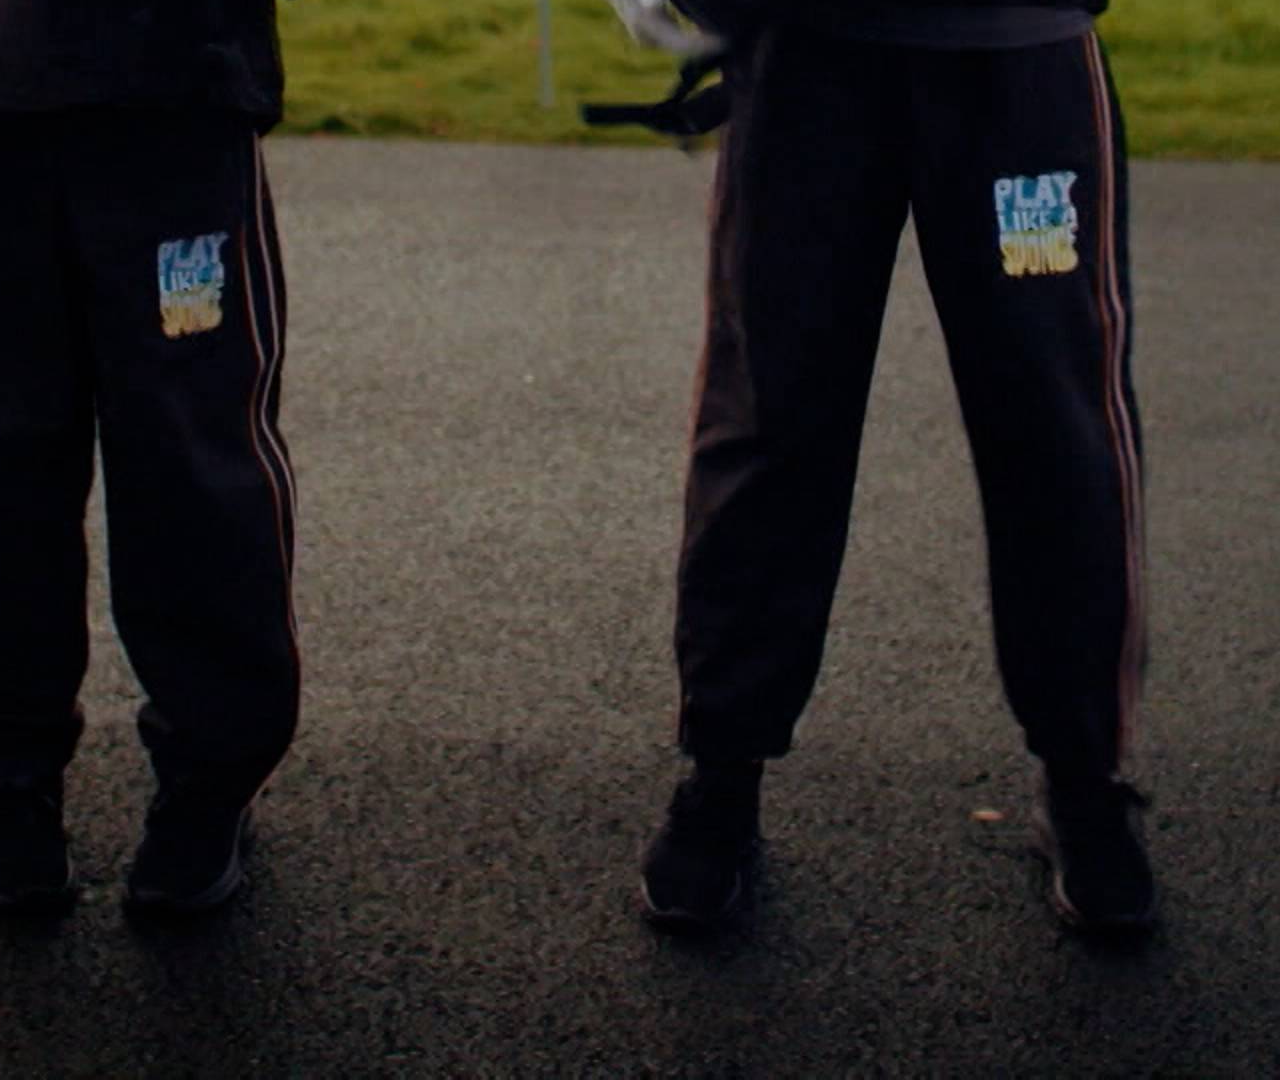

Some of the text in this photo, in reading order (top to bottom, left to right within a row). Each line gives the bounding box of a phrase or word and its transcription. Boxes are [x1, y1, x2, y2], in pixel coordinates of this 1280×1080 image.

[994, 170, 1080, 211] PLAY
[997, 207, 1061, 234] LIKE
[157, 230, 230, 273] PLAY
